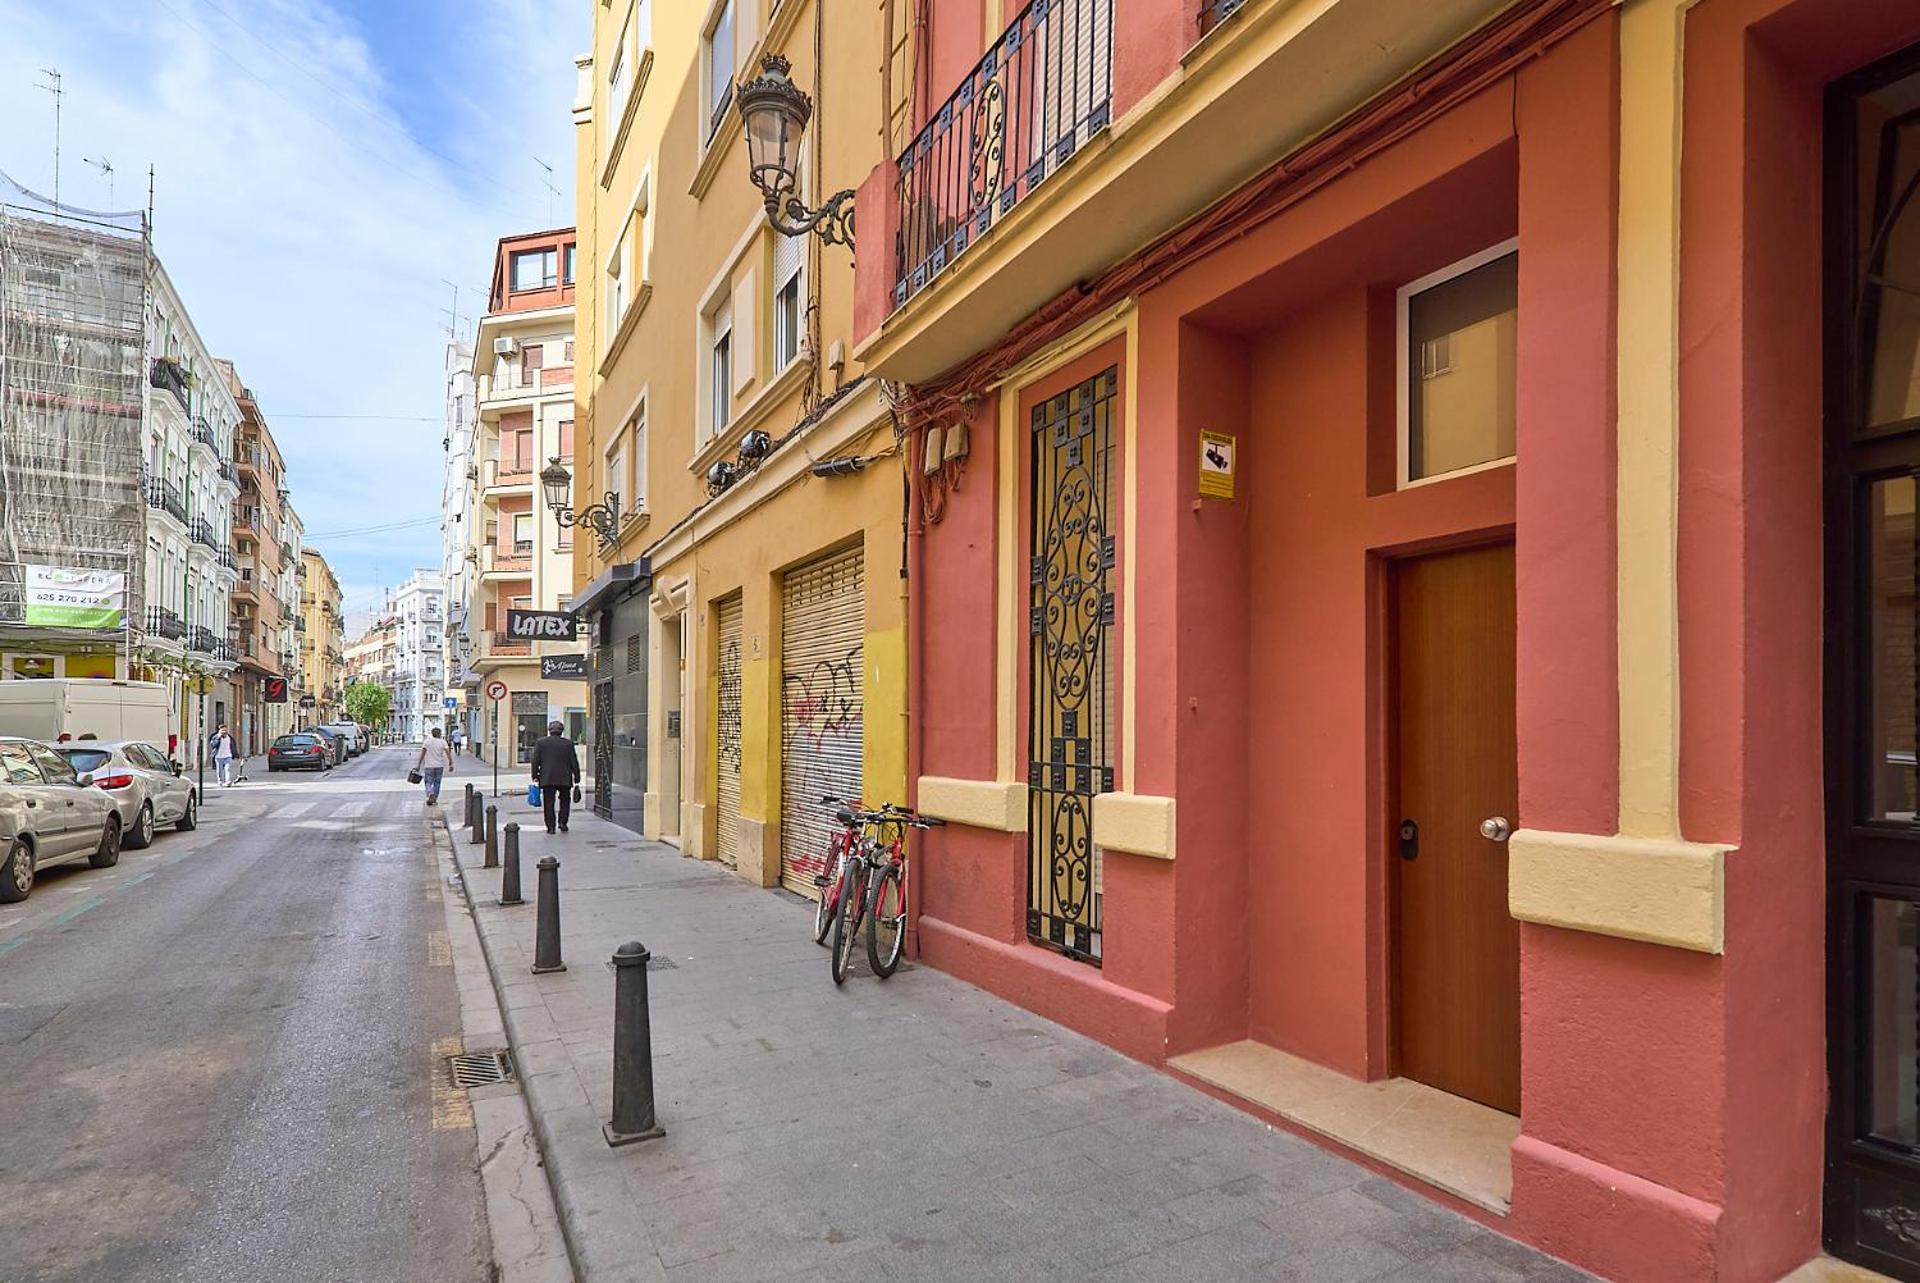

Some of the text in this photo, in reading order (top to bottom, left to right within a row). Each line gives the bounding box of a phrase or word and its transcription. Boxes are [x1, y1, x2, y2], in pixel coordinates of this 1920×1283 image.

[36, 593, 100, 604] 625 270 212
[512, 614, 571, 636] LATEX
